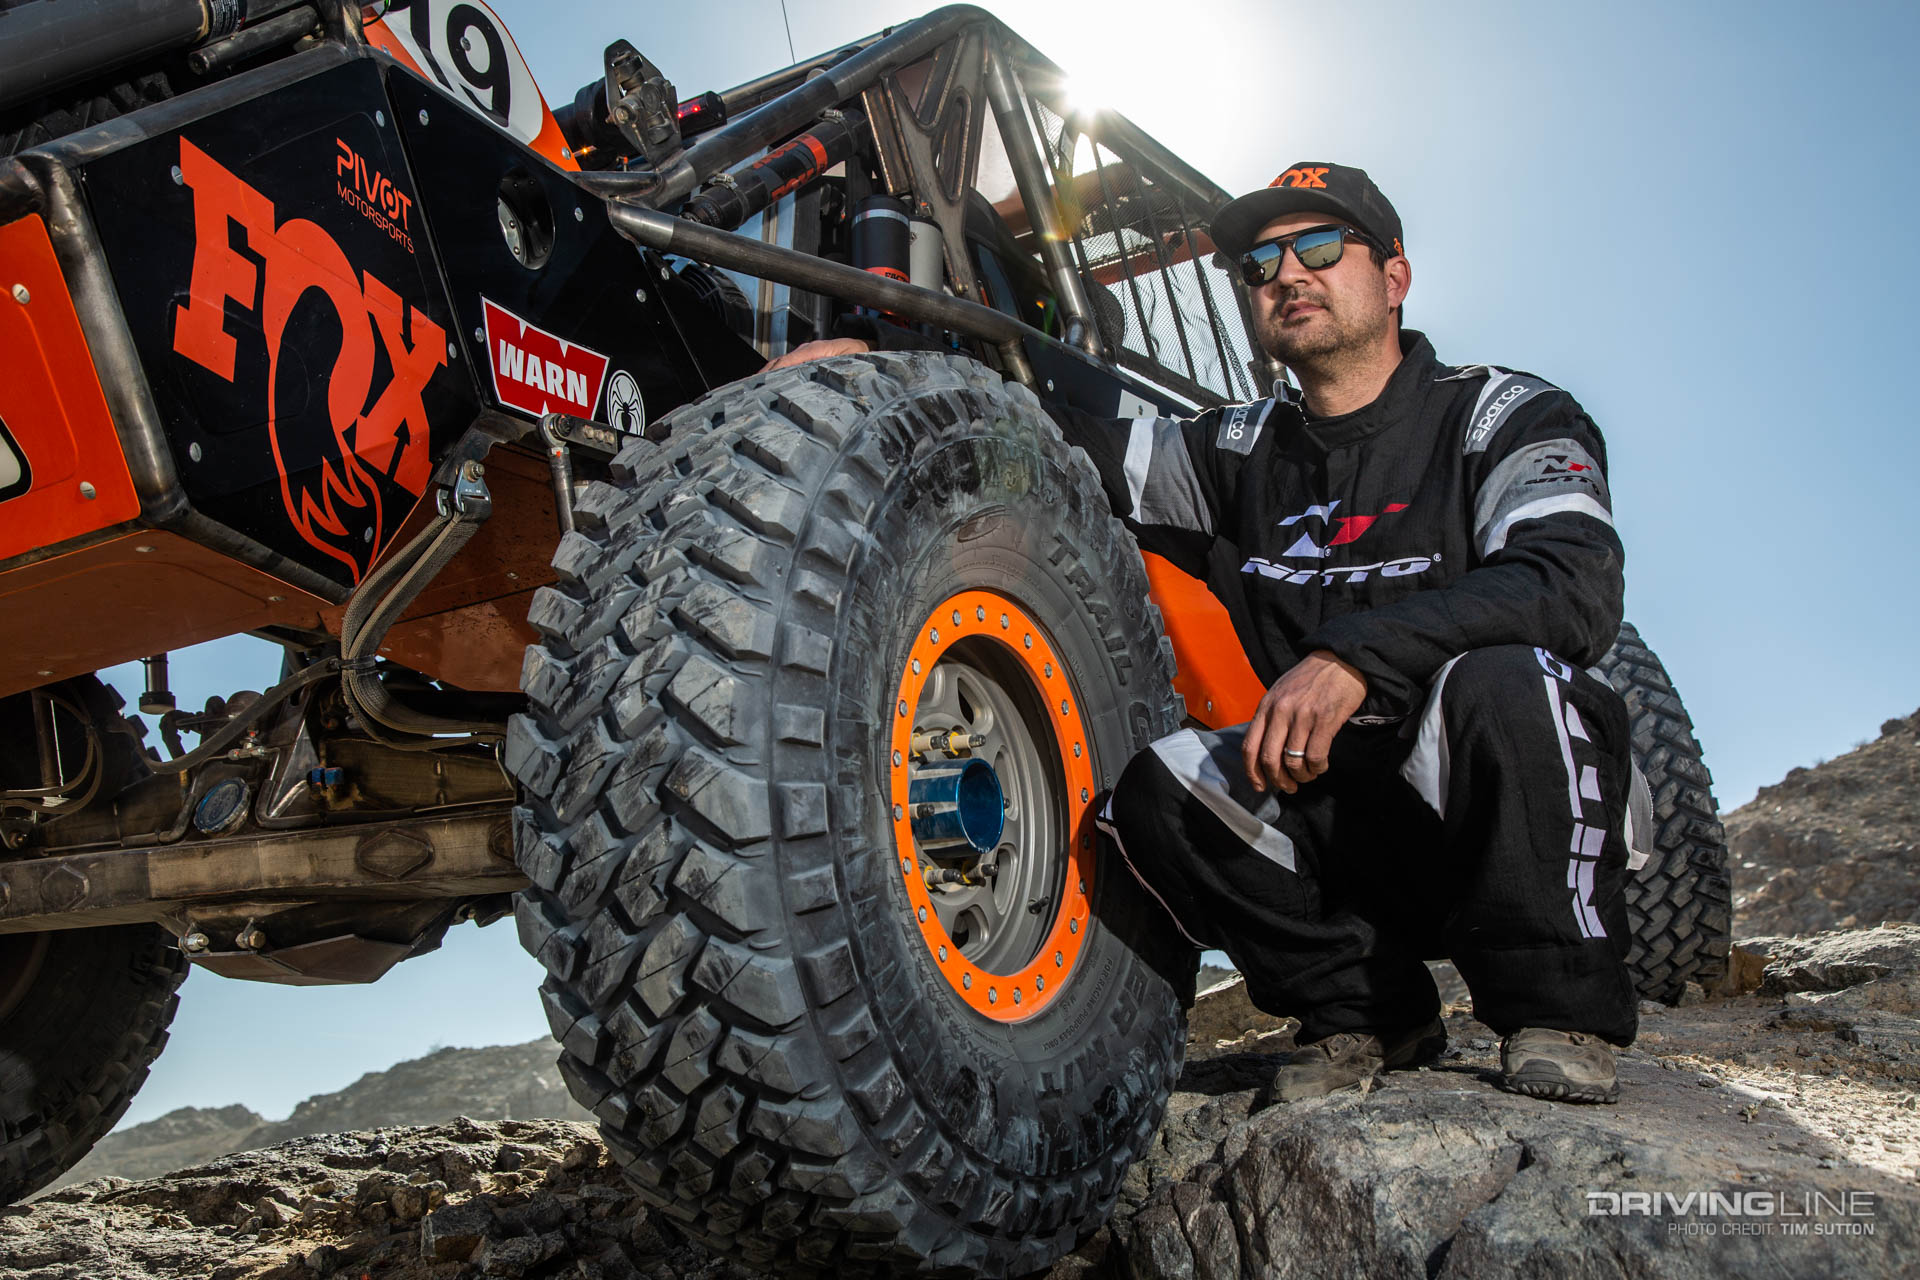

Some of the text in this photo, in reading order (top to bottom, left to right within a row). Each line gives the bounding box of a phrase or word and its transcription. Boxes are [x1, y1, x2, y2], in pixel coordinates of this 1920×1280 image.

[336, 137, 412, 230] PIVOT
[337, 180, 415, 255] MOTORSPORTS
[173, 135, 448, 587] FOX
[499, 338, 589, 408] WARN
[1472, 385, 1529, 442] sparco
[1048, 530, 1134, 686] TRAIL
[1059, 1008, 1090, 1042] PURPOSES
[1087, 978, 1107, 1010] RACING
